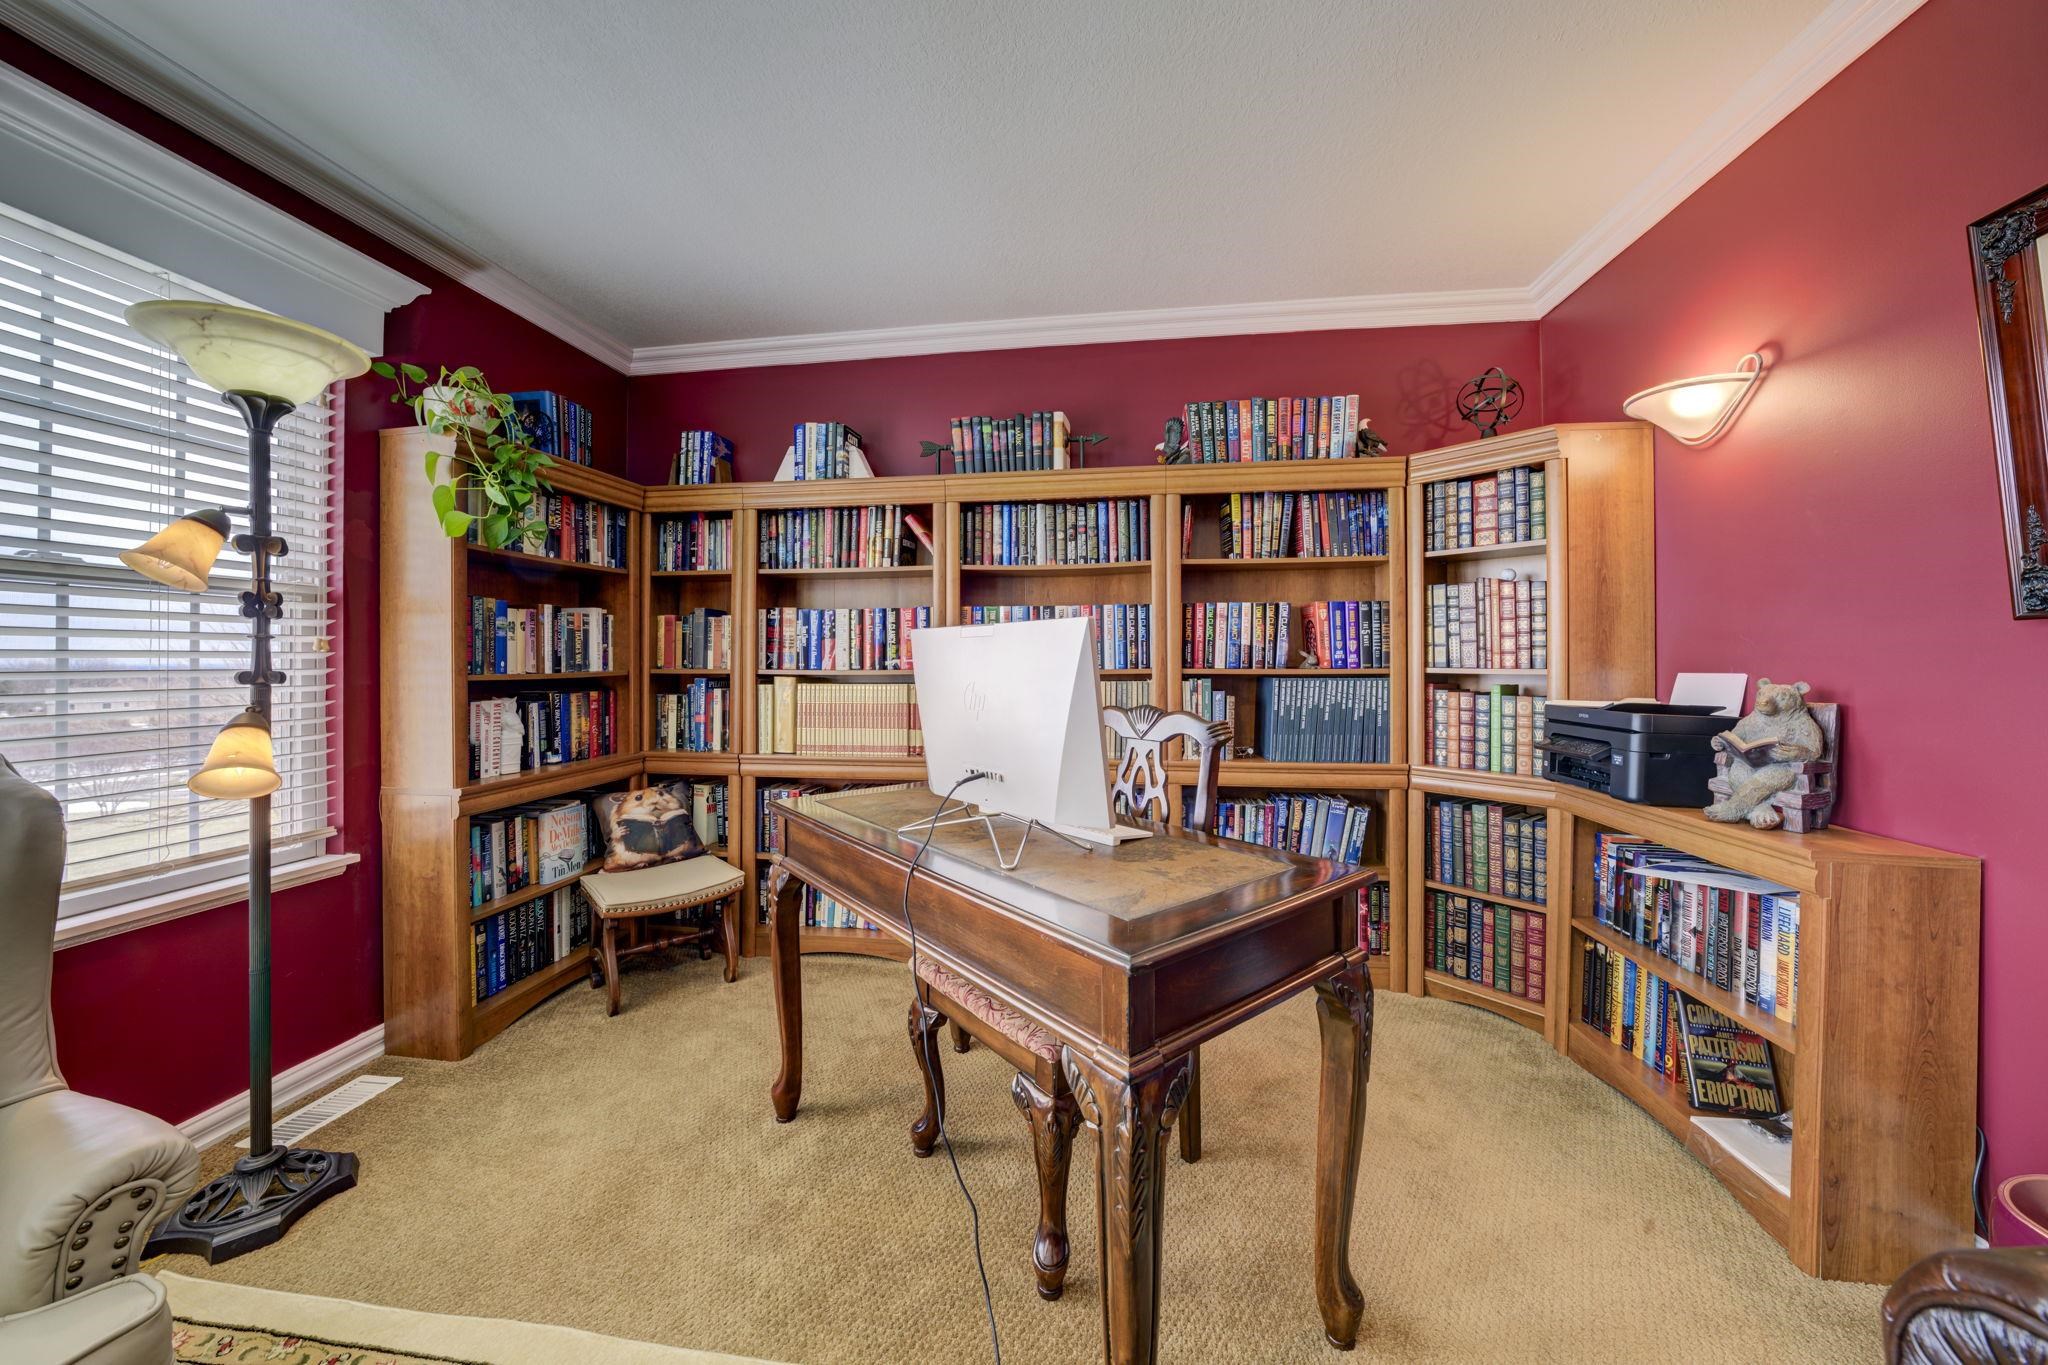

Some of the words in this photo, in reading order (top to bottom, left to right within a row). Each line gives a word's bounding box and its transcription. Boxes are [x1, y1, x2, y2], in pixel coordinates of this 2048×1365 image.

[964, 681, 988, 722] hp
[493, 703, 503, 733] MICHAEL
[492, 736, 501, 770] CRICHTON
[552, 866, 566, 878] Tin
[567, 862, 581, 874] Men
[1762, 897, 1774, 942] HONEYMOON
[1777, 906, 1792, 956] LIFEGUARD
[1717, 918, 1729, 958] PATTERSON
[1733, 937, 1742, 958] DON'T
[1733, 960, 1742, 980] BLINK
[1746, 956, 1758, 994] PATTERSON
[1778, 959, 1789, 978] JAMES
[1777, 978, 1789, 1008] PATTERSON
[1688, 1034, 1768, 1064] PATTERSON
[1716, 1032, 1735, 1040] JAMES
[1696, 1078, 1778, 1114] ERUPTION
